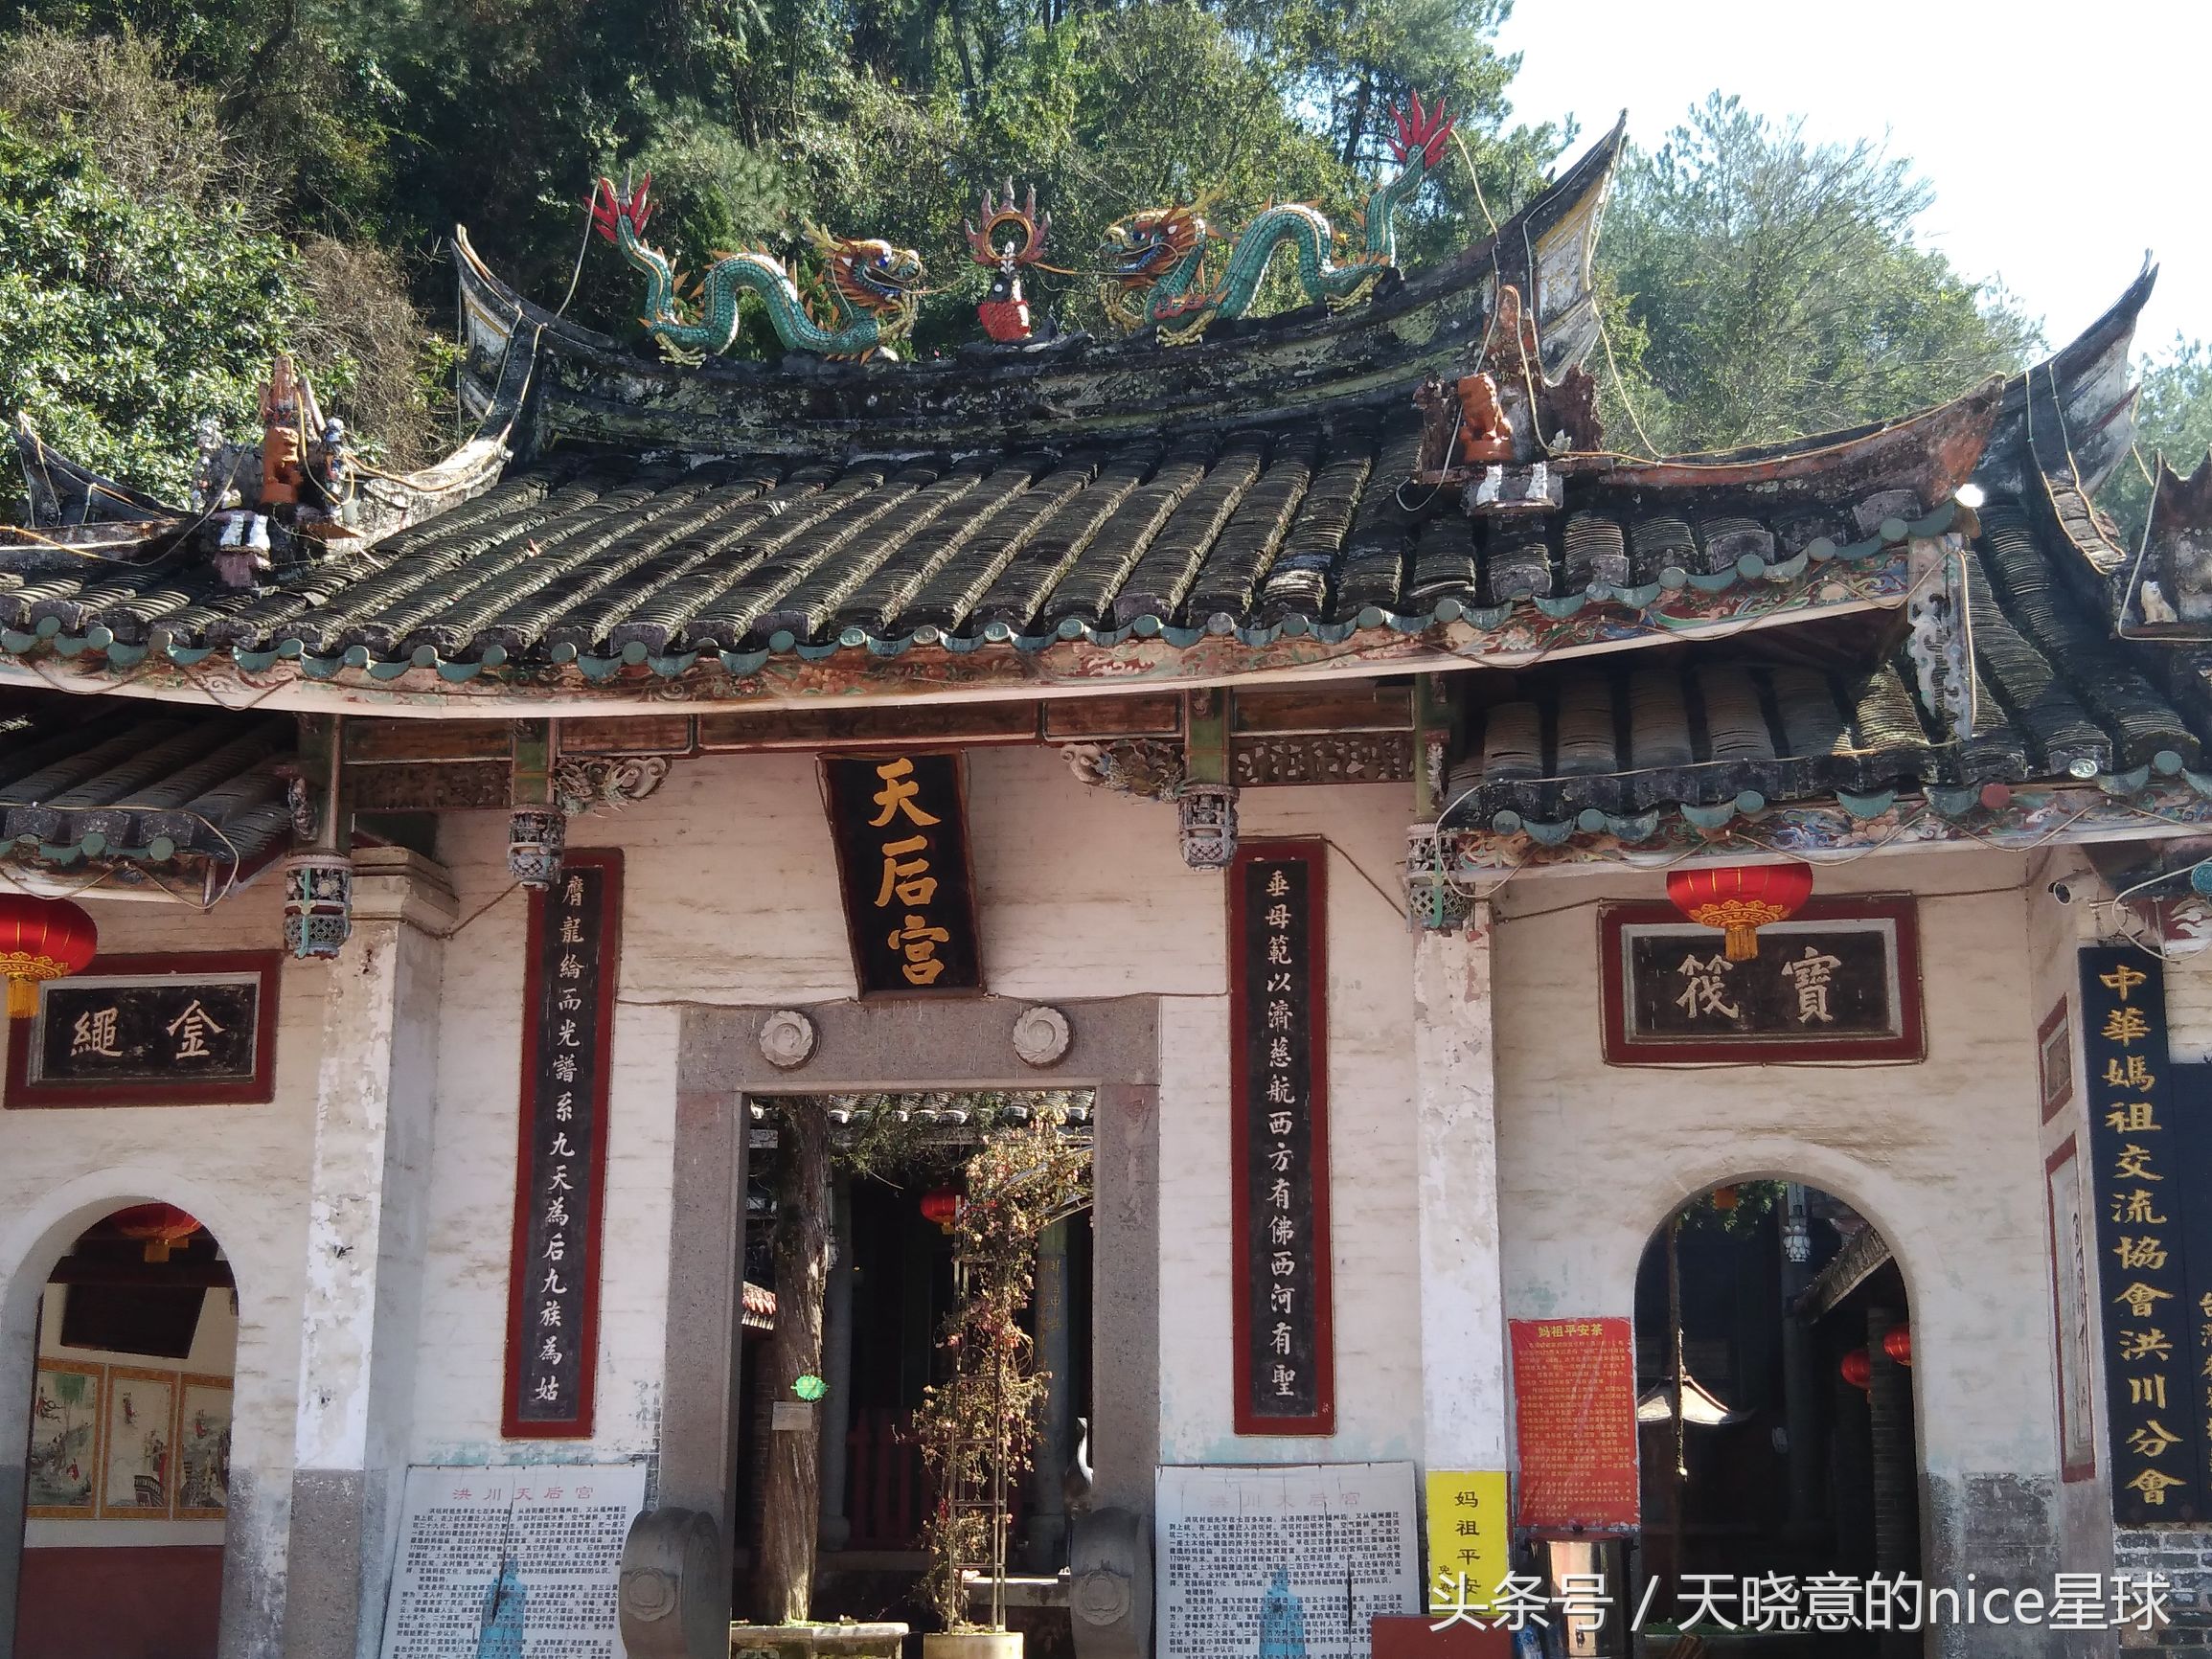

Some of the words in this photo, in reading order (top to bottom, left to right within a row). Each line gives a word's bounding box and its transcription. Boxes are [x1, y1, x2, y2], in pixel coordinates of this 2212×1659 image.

[1538, 1323, 1603, 1338] 妈祖平安茶
[2099, 965, 2187, 1505] 中華媽祖交流協會洪川分會
